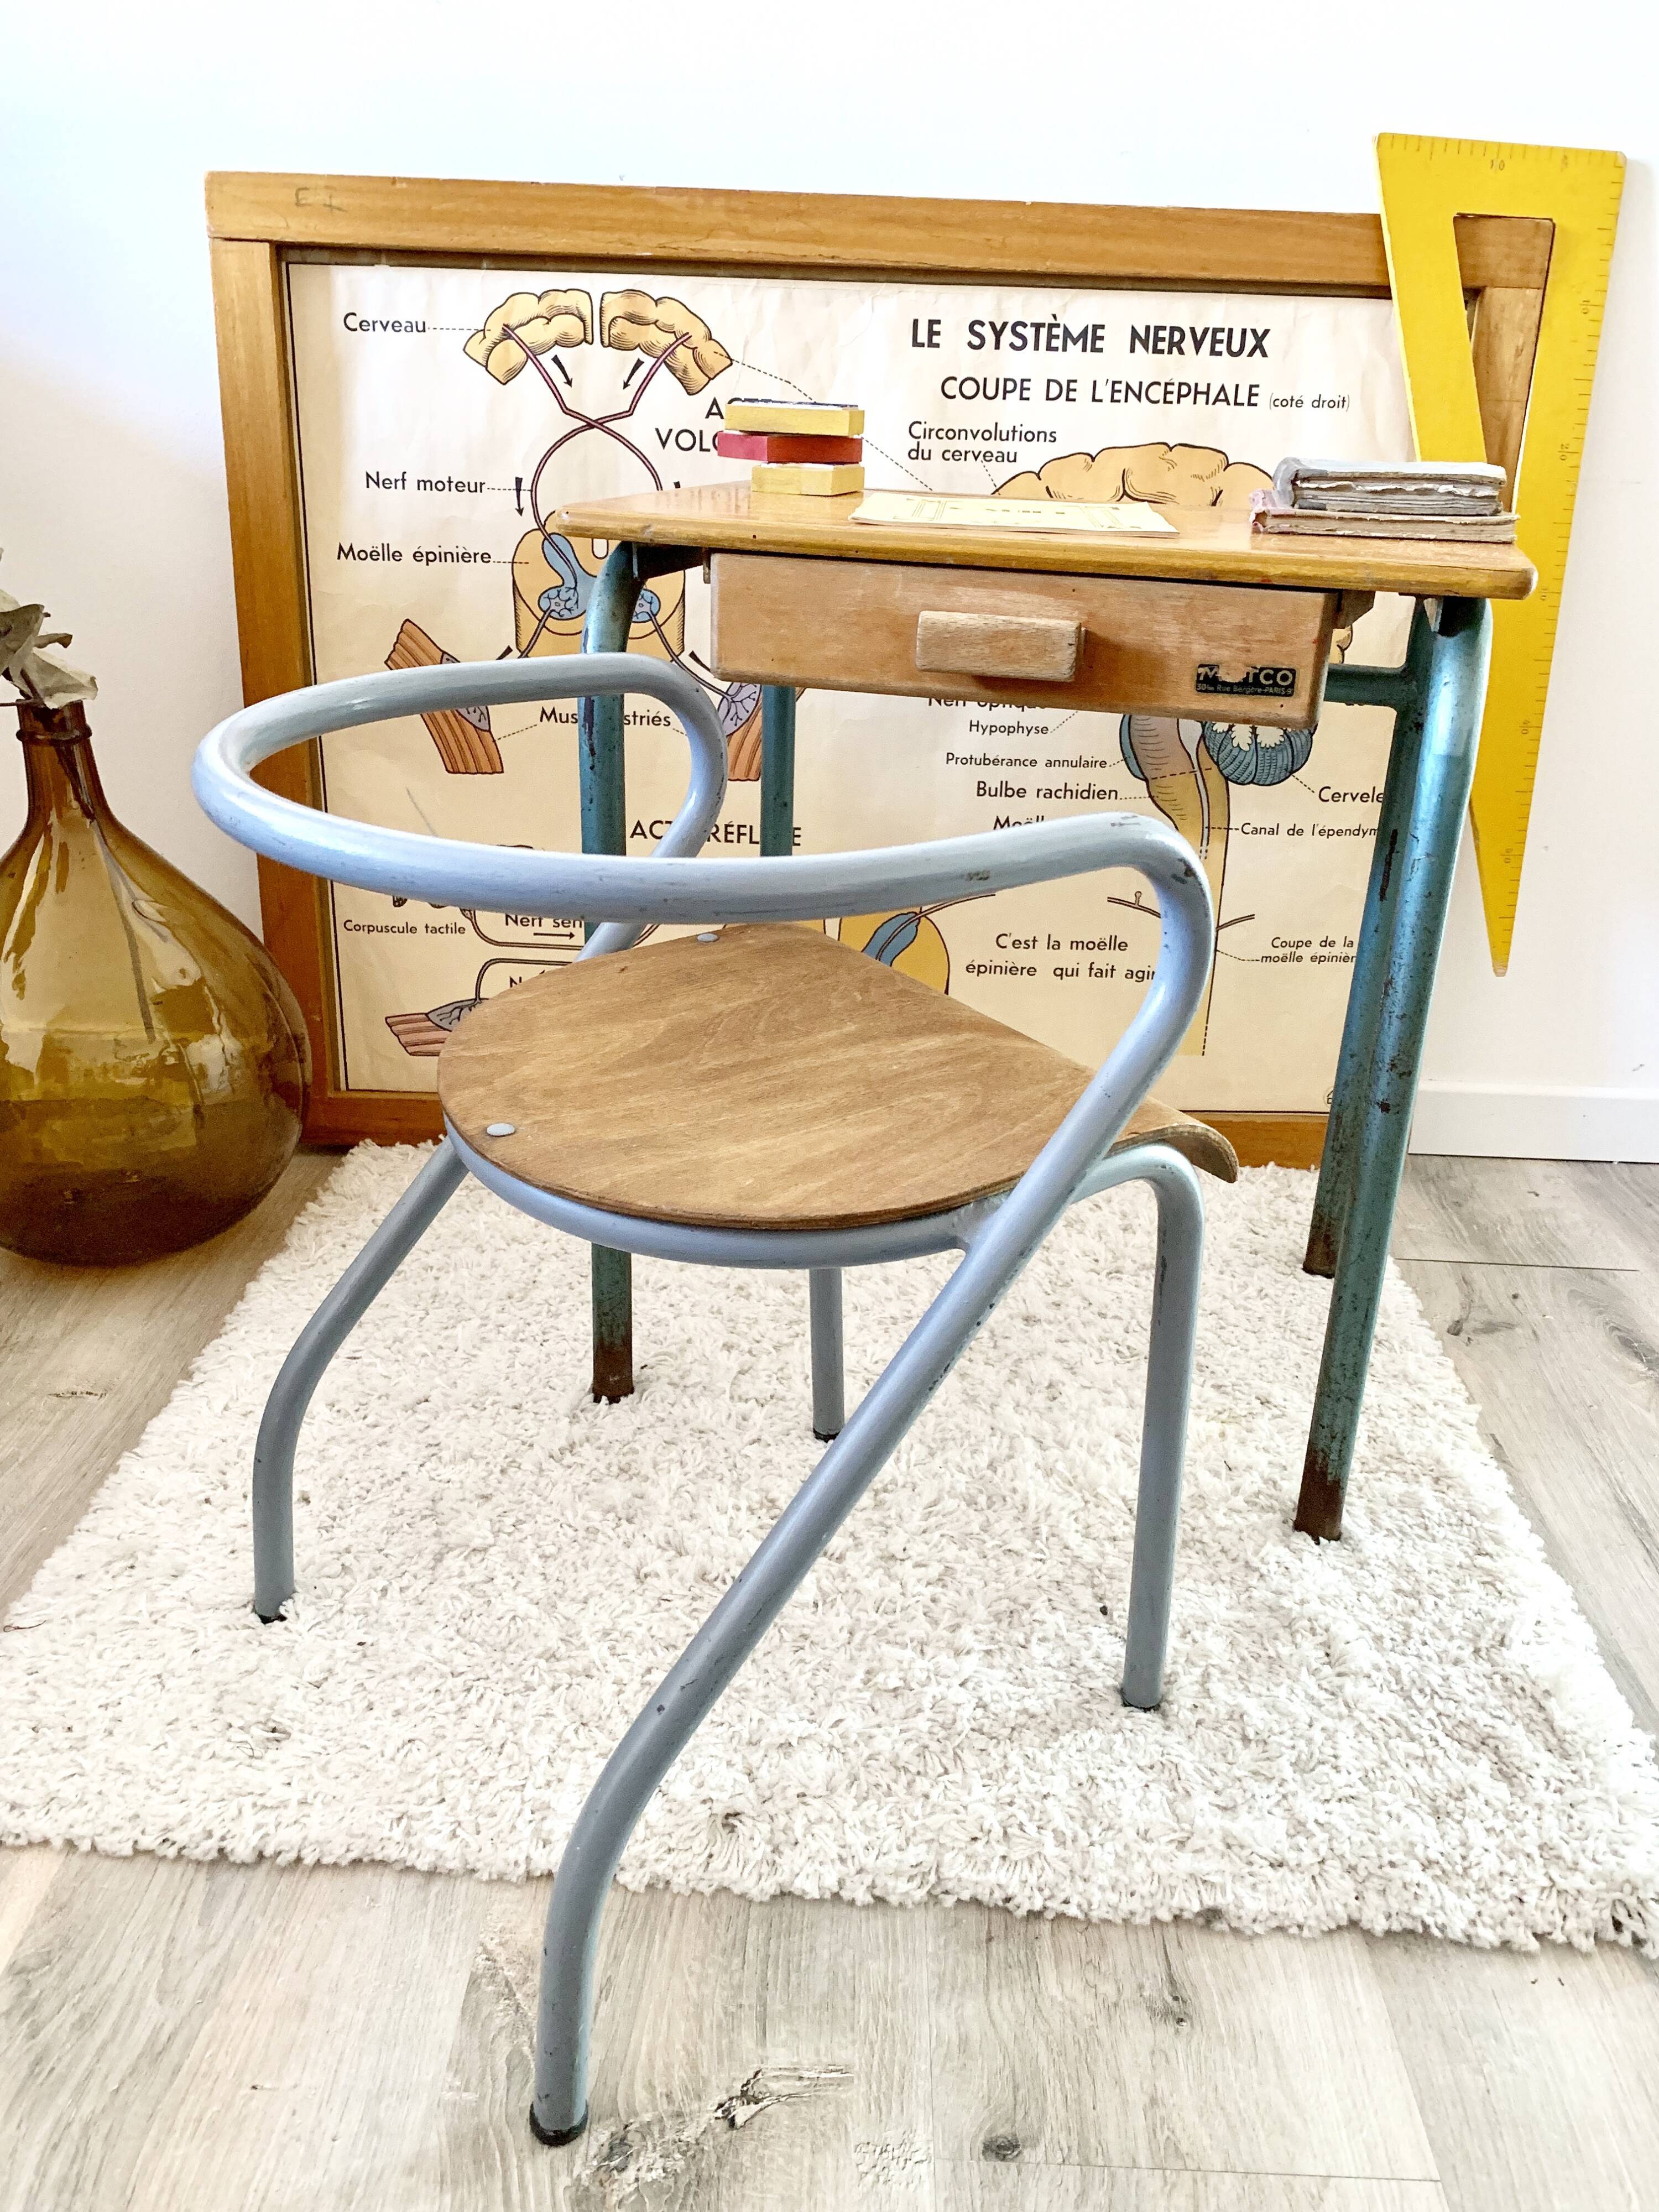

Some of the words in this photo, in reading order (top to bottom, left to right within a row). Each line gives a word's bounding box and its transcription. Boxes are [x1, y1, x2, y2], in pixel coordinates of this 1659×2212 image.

[343, 312, 426, 333] Cerveau
[912, 319, 941, 348] LE
[967, 314, 1105, 353] SYSTÈME
[1129, 324, 1271, 358] NERVEUX
[941, 376, 1031, 401] COUPE
[1045, 378, 1078, 402] DE
[1091, 378, 1260, 407] L'ENCÉPHALE
[1311, 393, 1350, 412] droit)
[909, 420, 1057, 443] Circonvolutions
[907, 442, 932, 461] du
[941, 449, 1018, 463] cerveau
[366, 471, 407, 490] Nerf
[417, 476, 486, 493] moteur
[337, 542, 403, 562] Moëlle
[413, 545, 492, 566] épinière
[969, 719, 1049, 737] Hypophyse
[946, 752, 1037, 768] Protubérance
[1045, 755, 1107, 769] annulaire
[977, 780, 1027, 799] Bulbe
[1036, 782, 1118, 800] rachidien
[1316, 784, 1384, 804] Cervele
[1241, 822, 1280, 836] Canal
[1286, 823, 1304, 836] de
[343, 919, 418, 935] Corpuscule
[424, 922, 466, 935] tactile
[995, 932, 1038, 950] C'est
[1046, 933, 1061, 951] la
[1070, 935, 1128, 951] moëlle
[1271, 936, 1312, 950] Coupe
[1319, 935, 1336, 948] de
[1343, 936, 1354, 948] la
[1261, 950, 1304, 963] moëlle
[966, 959, 1037, 977] épinière
[1053, 962, 1080, 980] qui
[1088, 961, 1117, 978] fait
